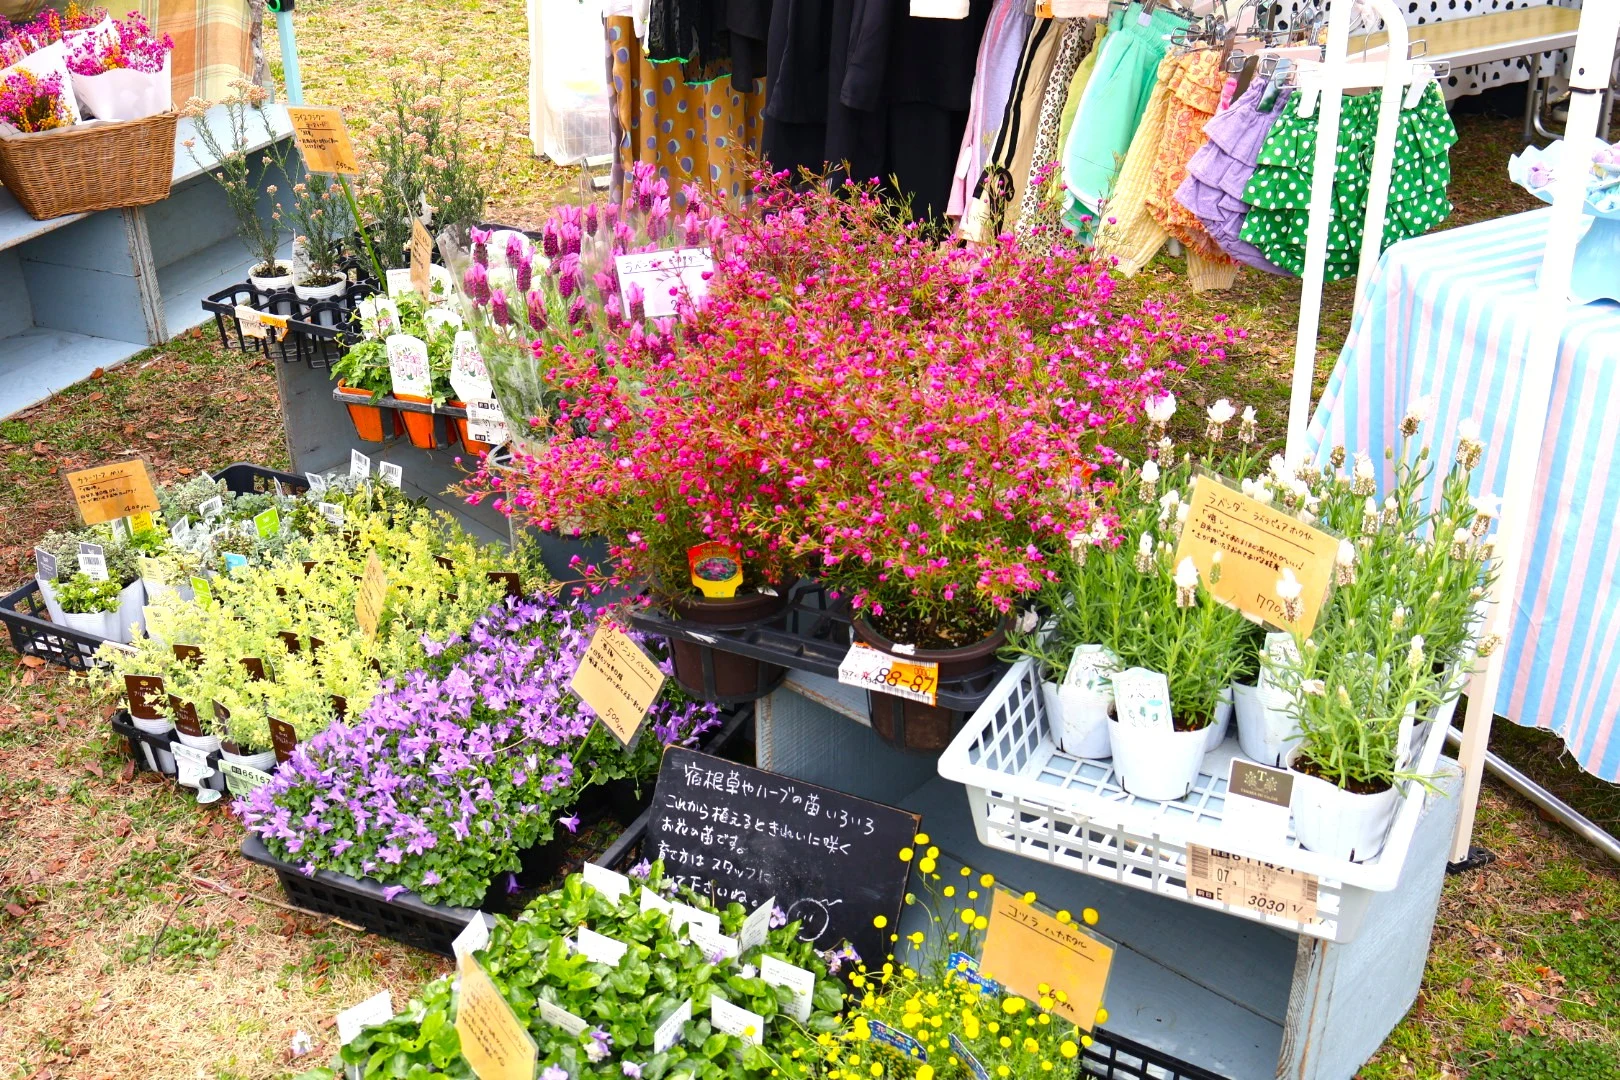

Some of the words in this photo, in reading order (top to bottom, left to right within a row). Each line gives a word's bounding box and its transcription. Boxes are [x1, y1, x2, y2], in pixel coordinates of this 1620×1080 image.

[1208, 491, 1248, 513] ラベンダー
[876, 667, 935, 695] 88-87
[1248, 894, 1286, 912] 3030
